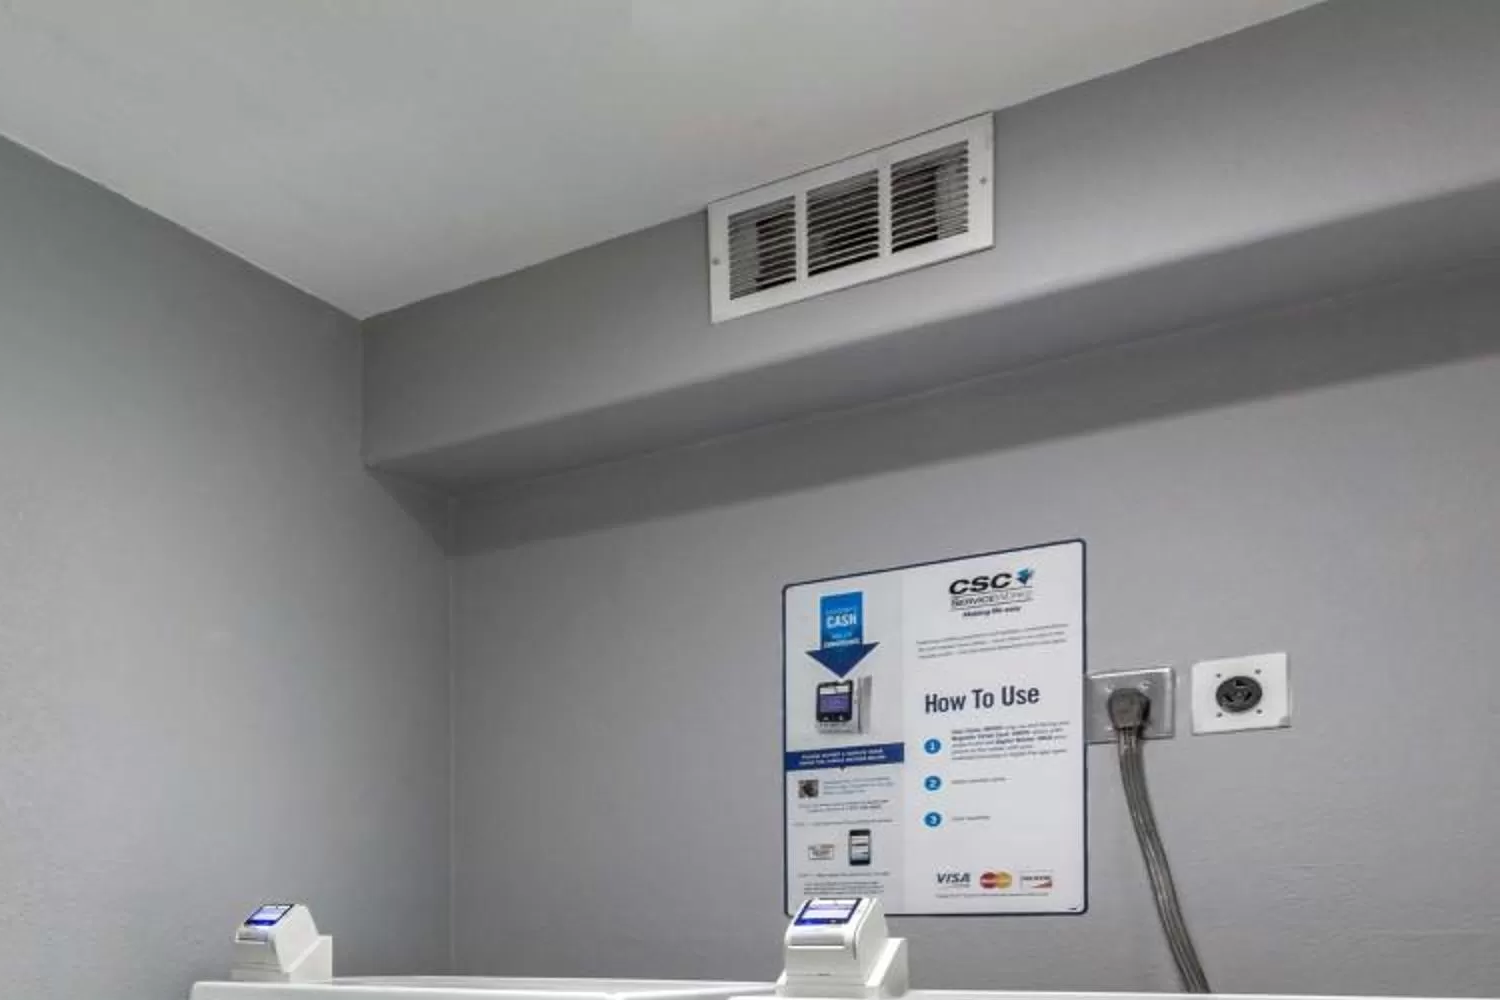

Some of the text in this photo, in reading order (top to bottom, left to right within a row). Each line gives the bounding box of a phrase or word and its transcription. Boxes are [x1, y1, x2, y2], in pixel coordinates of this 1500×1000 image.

[949, 573, 1012, 595] CSC
[826, 613, 857, 629] CASH
[925, 685, 1040, 714] How To Use
[936, 872, 972, 884] VISA
